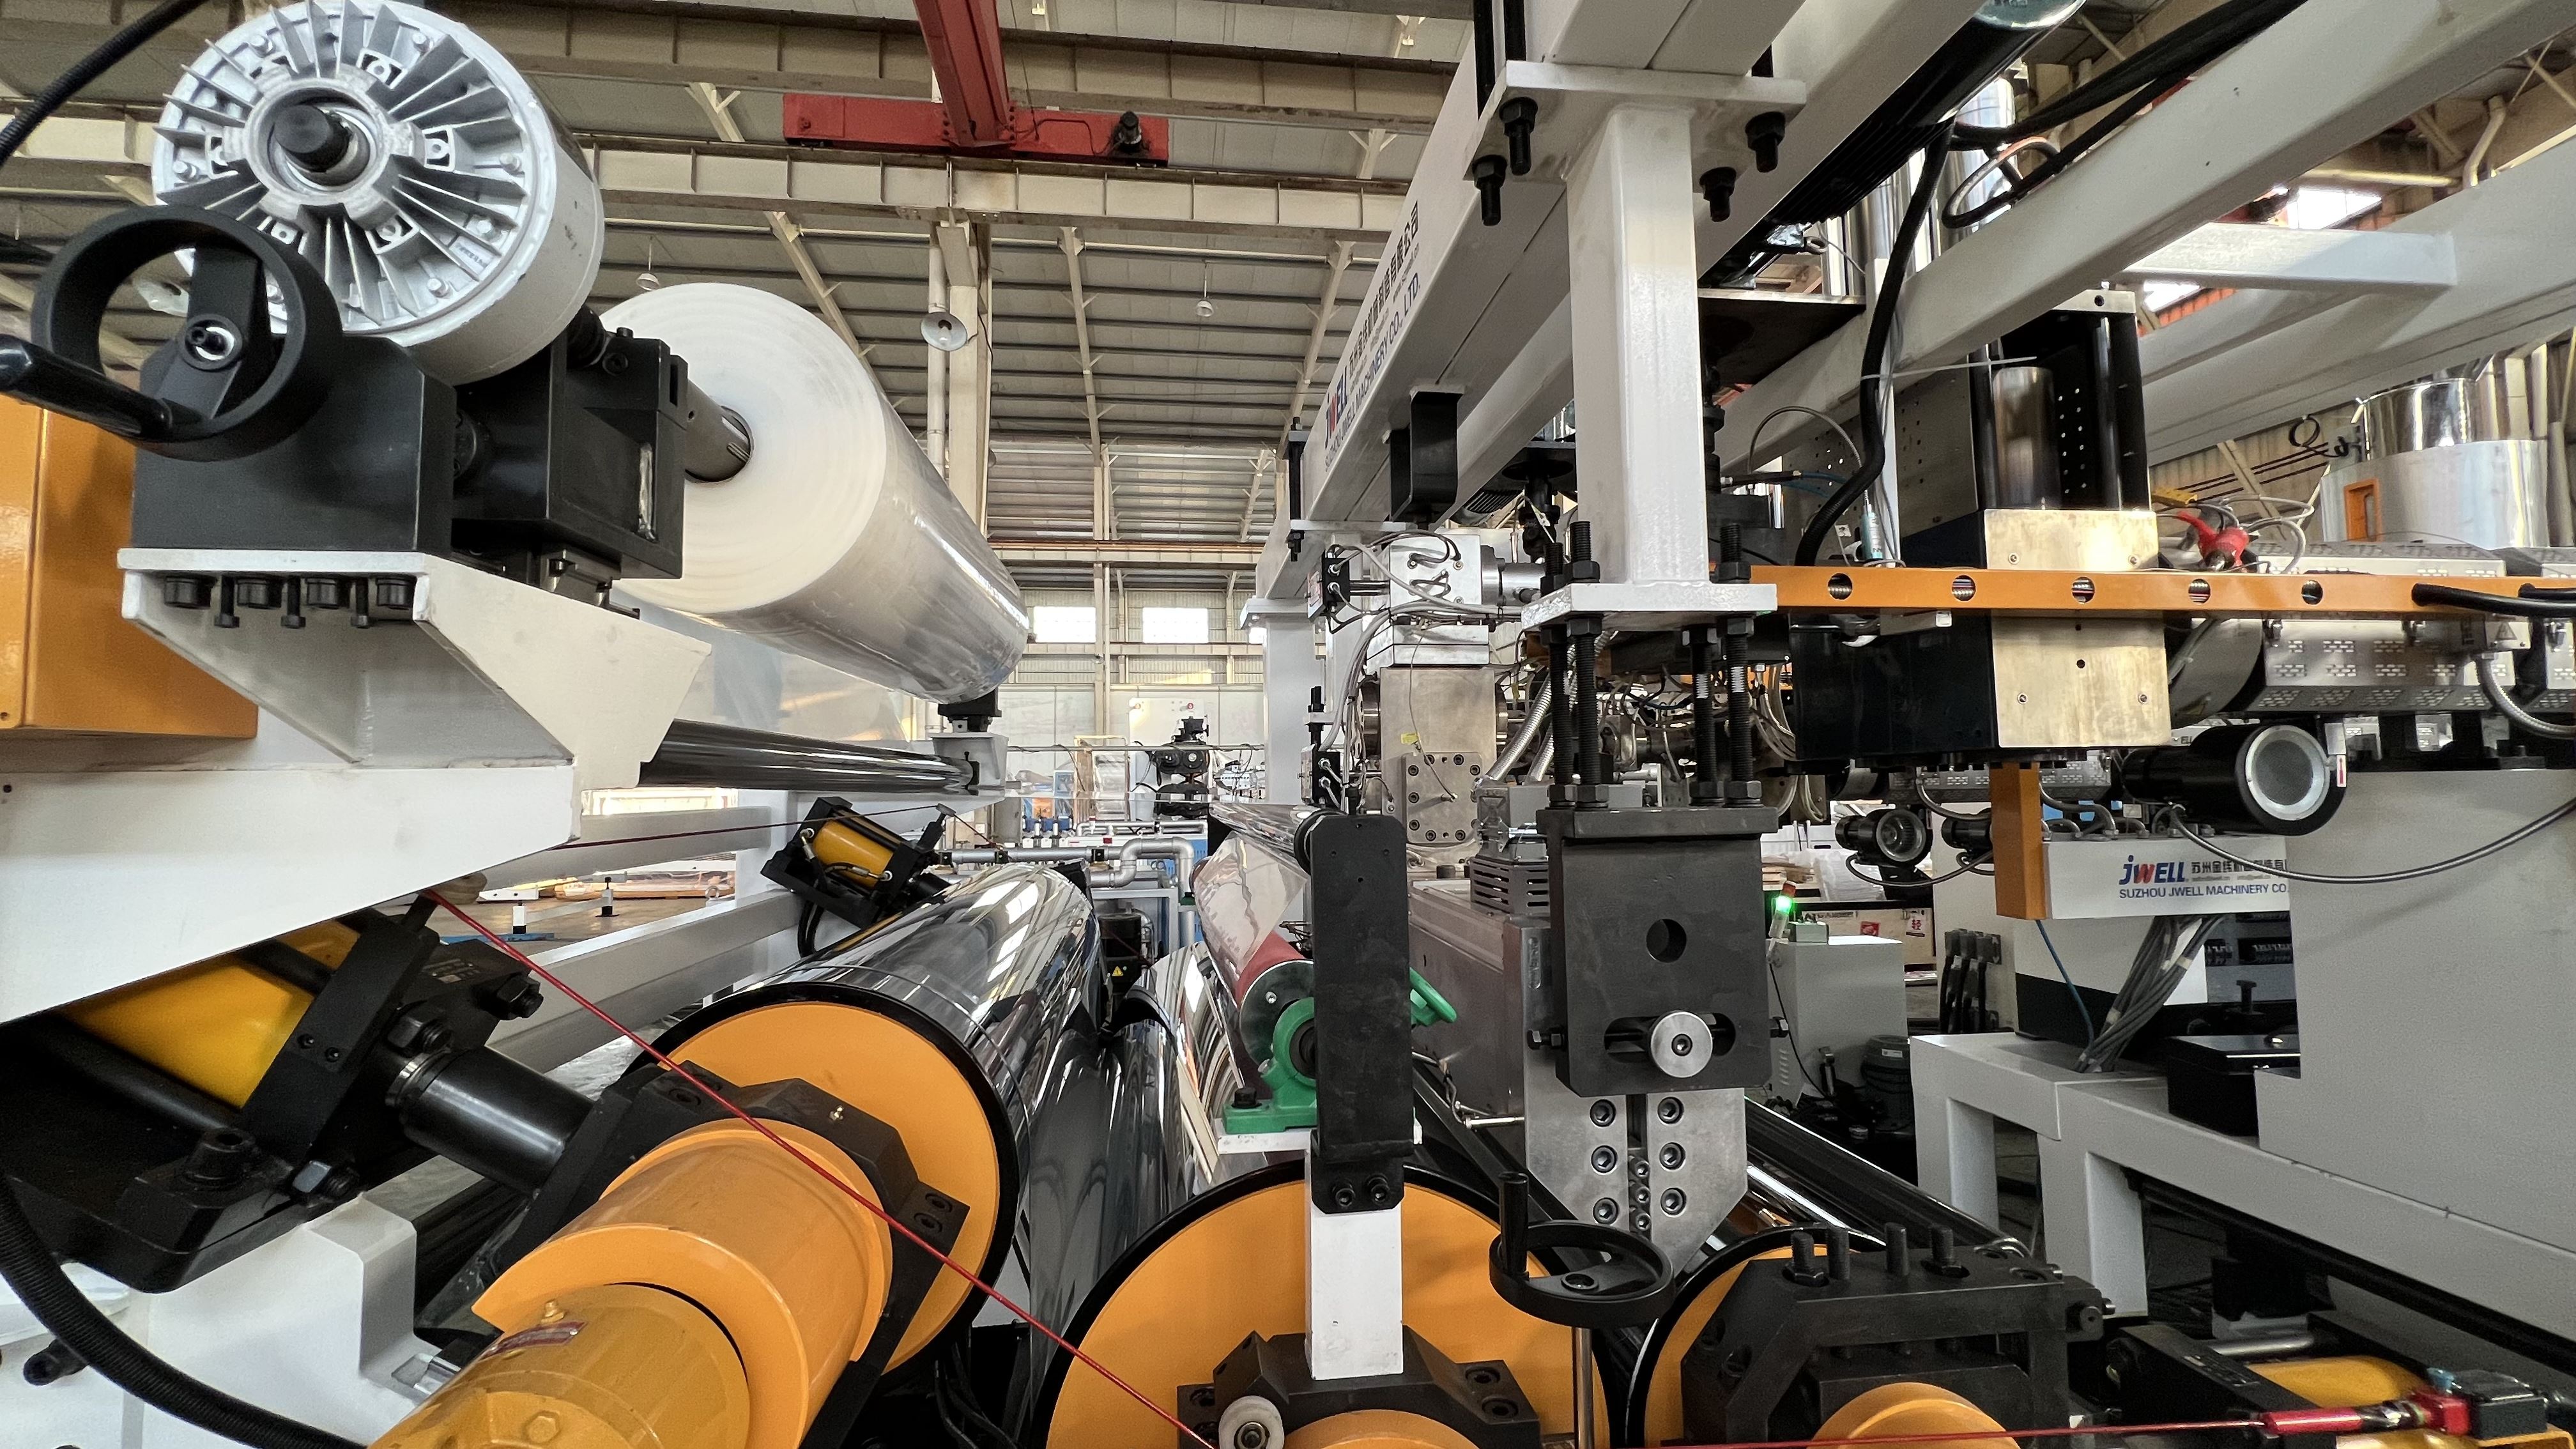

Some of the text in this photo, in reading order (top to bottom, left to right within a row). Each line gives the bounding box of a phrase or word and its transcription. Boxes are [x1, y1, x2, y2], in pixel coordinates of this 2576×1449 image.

[2119, 887, 2166, 899] SUZHOU
[2168, 885, 2204, 897] JWELL
[2205, 884, 2269, 895] MACHINERY
